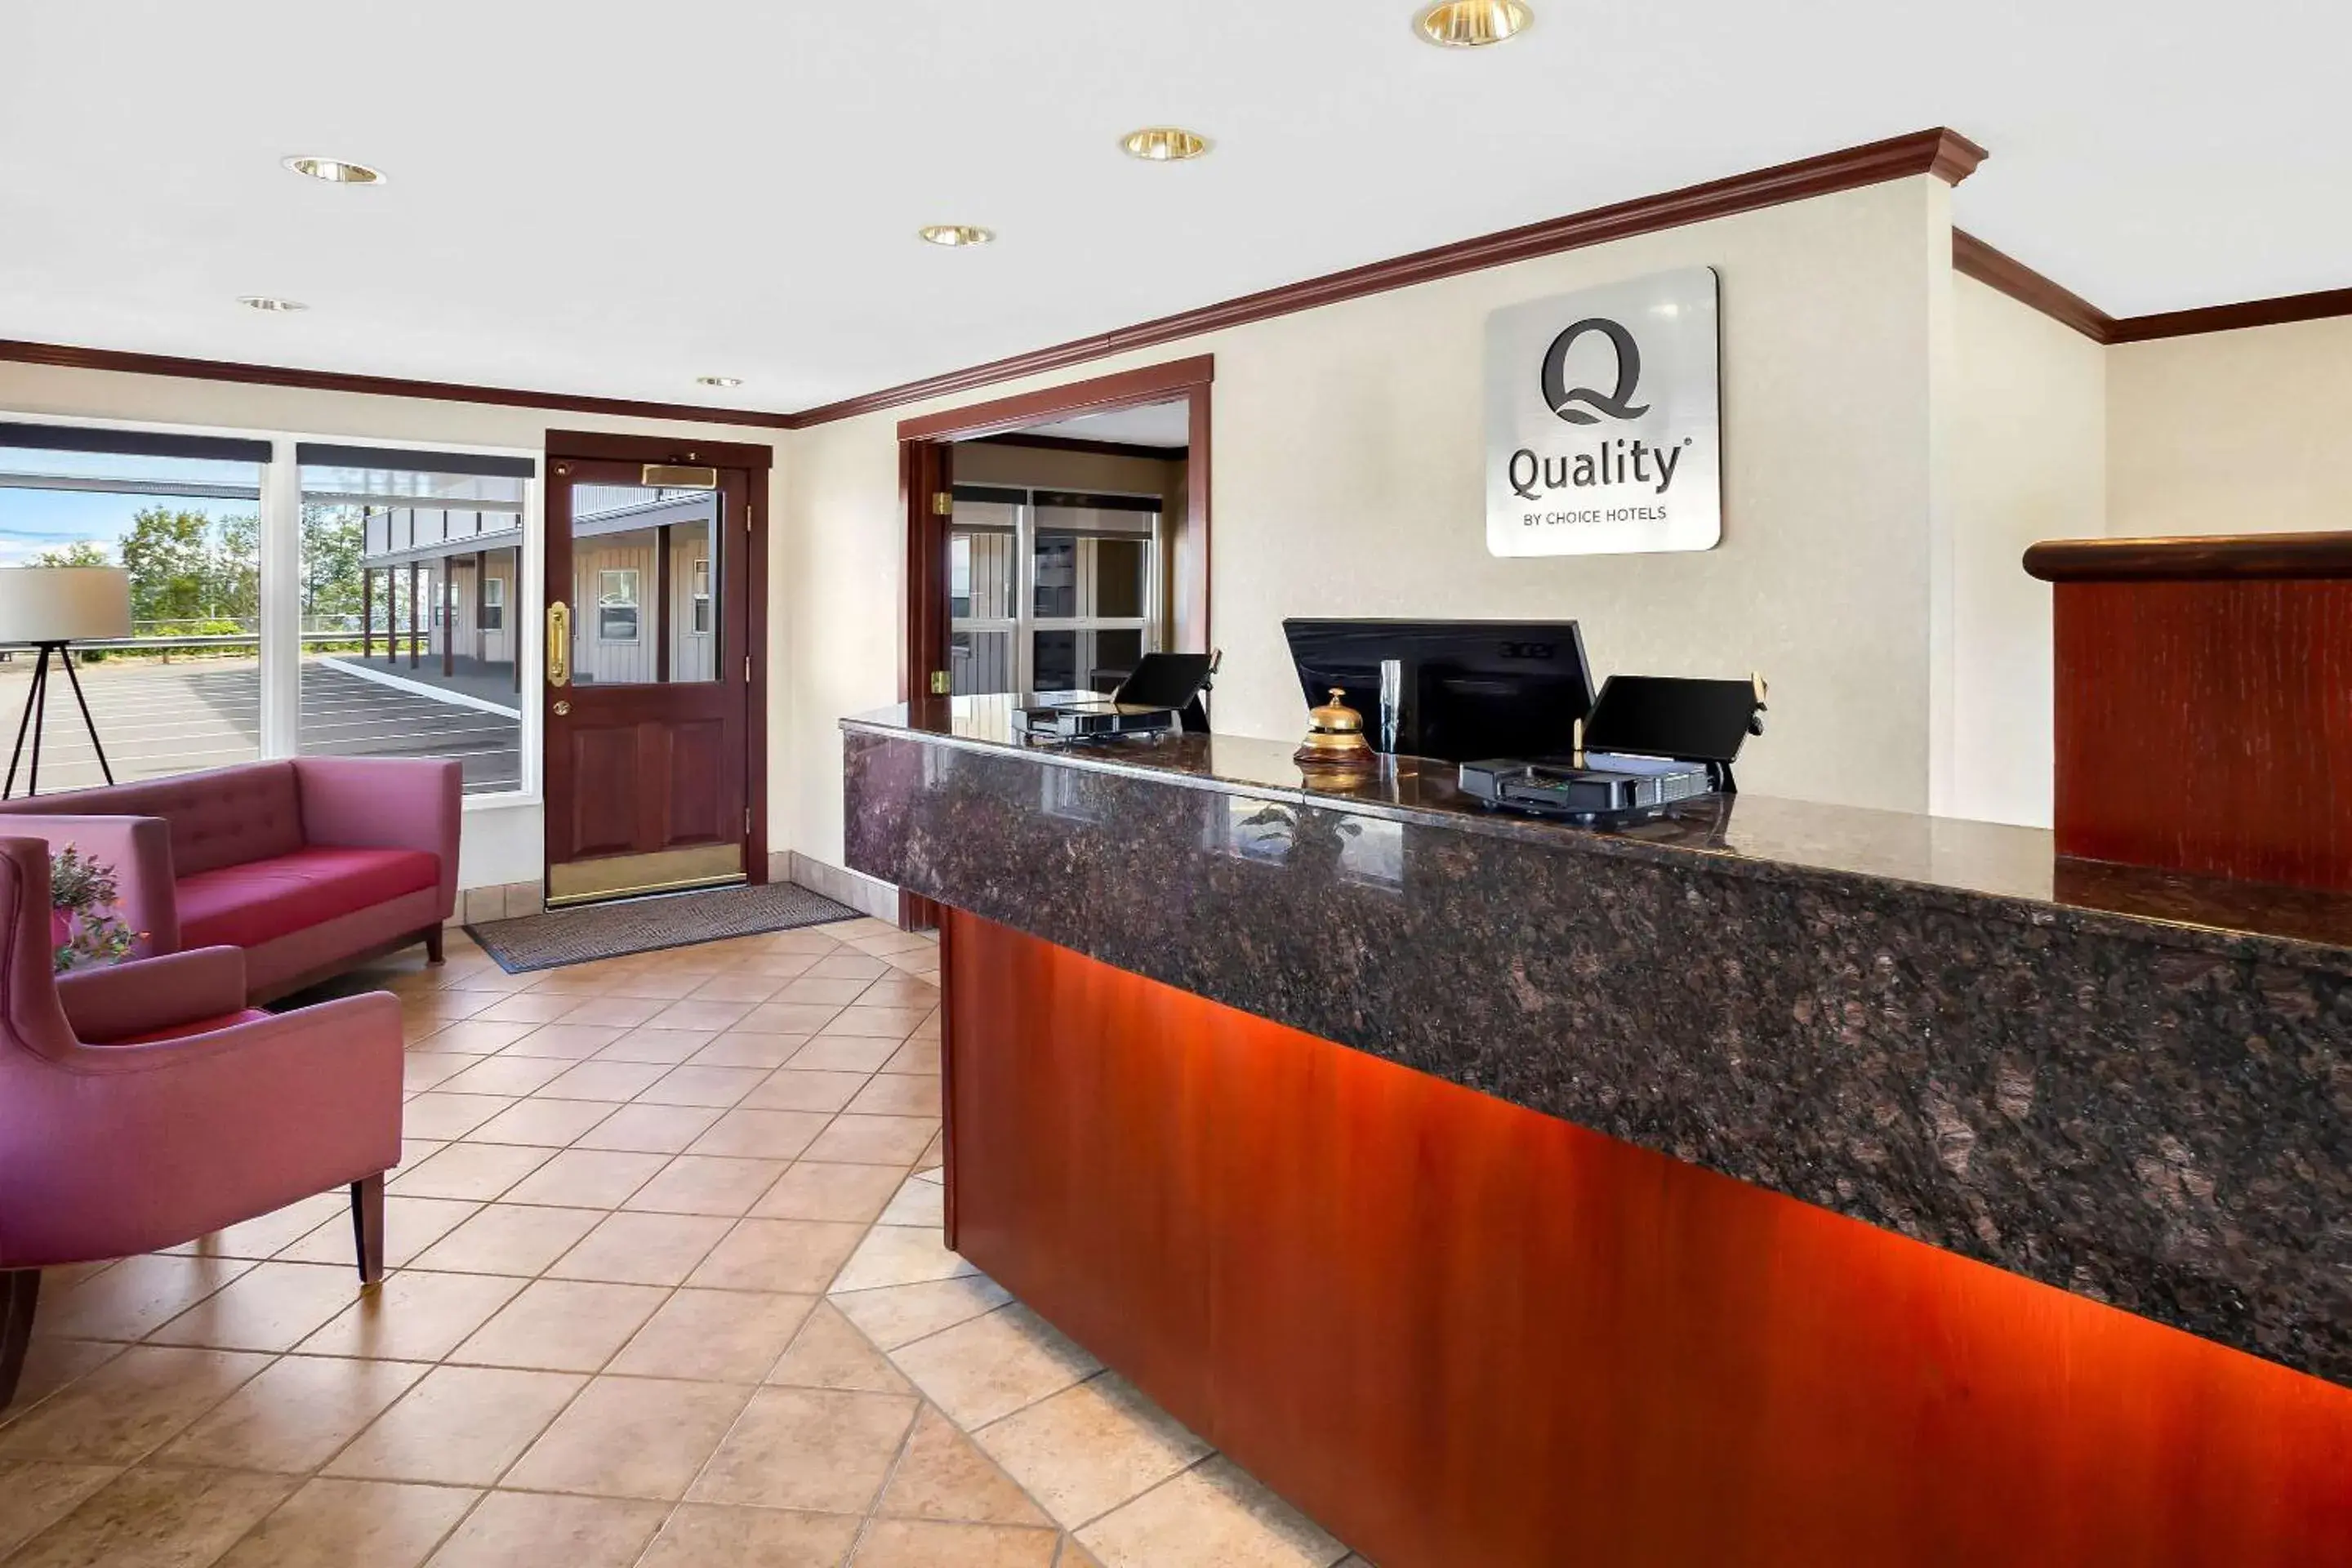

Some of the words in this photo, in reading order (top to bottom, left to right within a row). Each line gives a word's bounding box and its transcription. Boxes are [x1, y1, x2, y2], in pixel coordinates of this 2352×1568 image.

[1541, 317, 1651, 425] Q
[1523, 513, 1542, 527] BY
[1545, 510, 1601, 525] CHOICE
[1606, 506, 1667, 523] HOTELS
